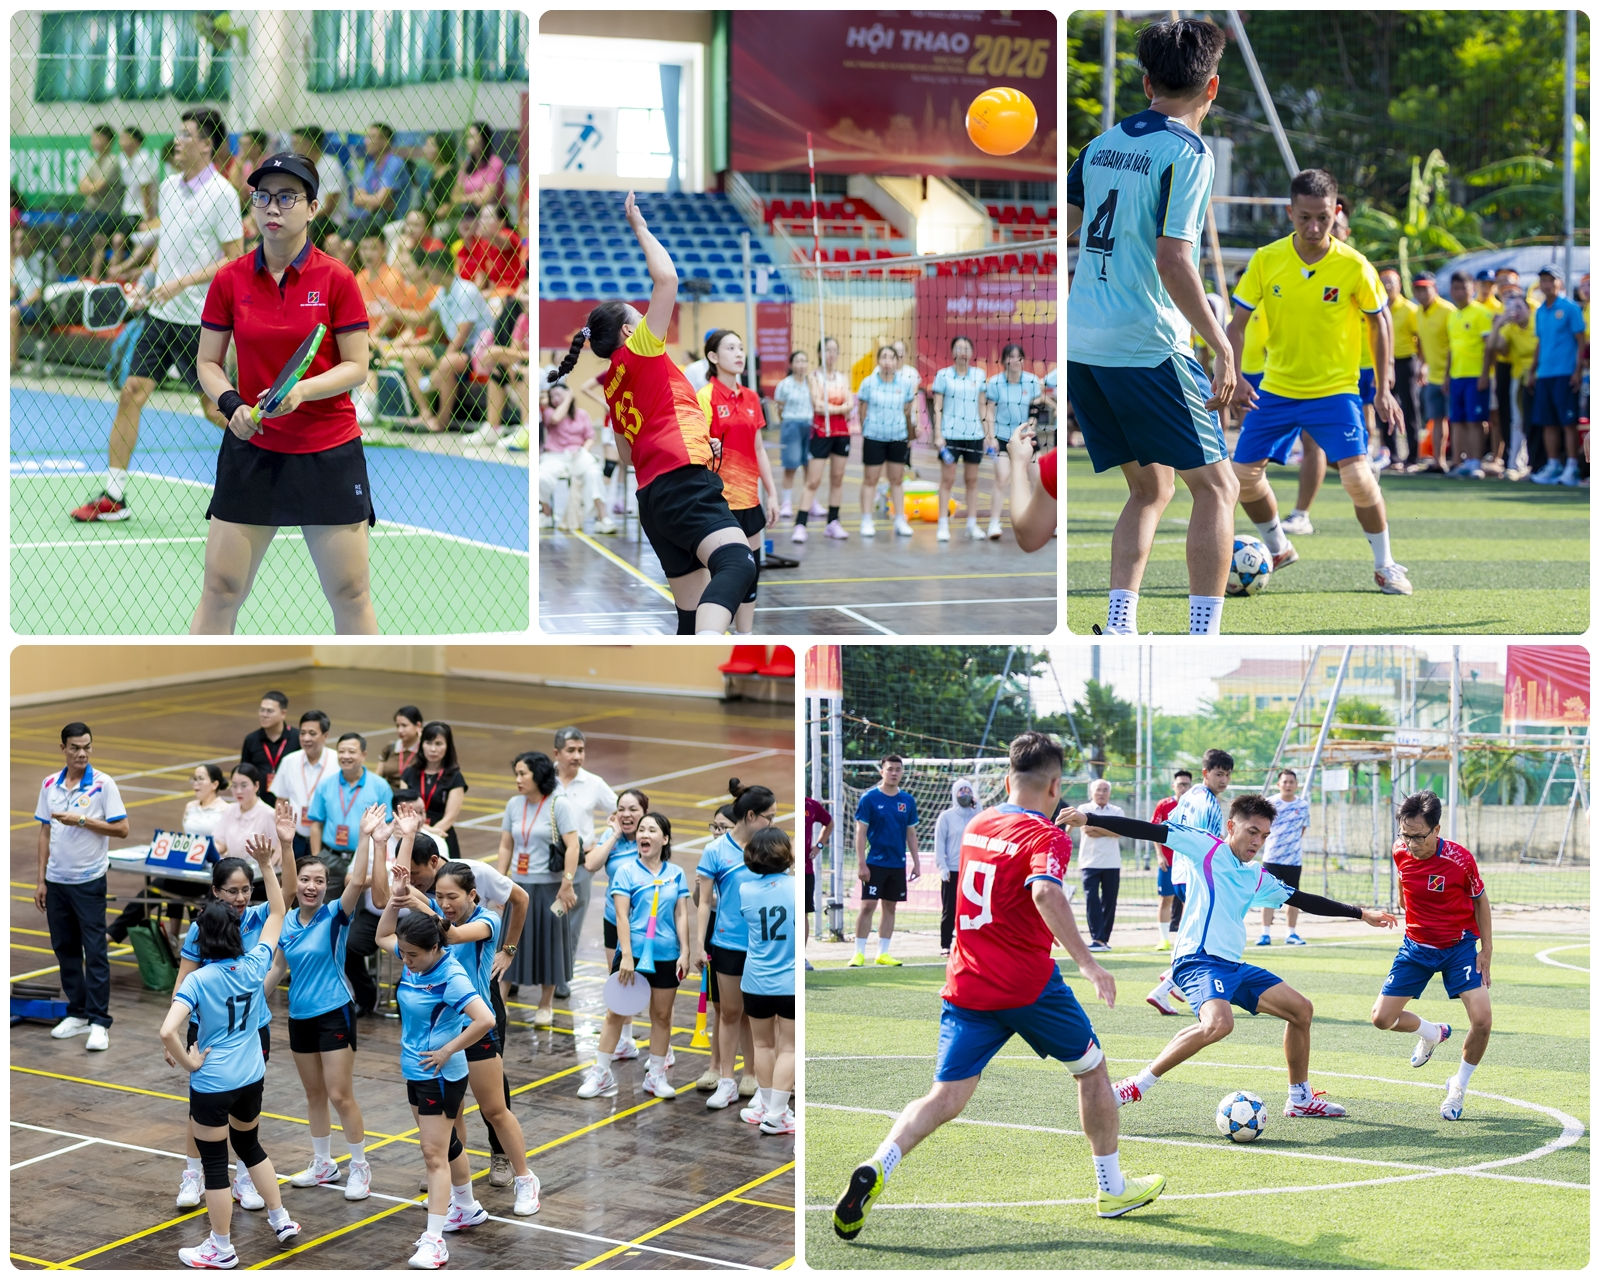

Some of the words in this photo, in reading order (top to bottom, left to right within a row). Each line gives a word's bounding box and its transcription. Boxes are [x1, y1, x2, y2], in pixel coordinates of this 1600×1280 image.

[846, 22, 895, 55] HỘI
[900, 28, 970, 54] THAO
[967, 34, 1050, 79] 2026
[1086, 189, 1119, 282] 4
[154, 839, 169, 857] 8
[190, 844, 205, 862] 2
[869, 885, 877, 896] 12
[959, 860, 997, 931] 9
[758, 905, 787, 941] 12
[1214, 979, 1225, 993] 8
[1463, 965, 1472, 981] 7
[226, 992, 253, 1036] 17
